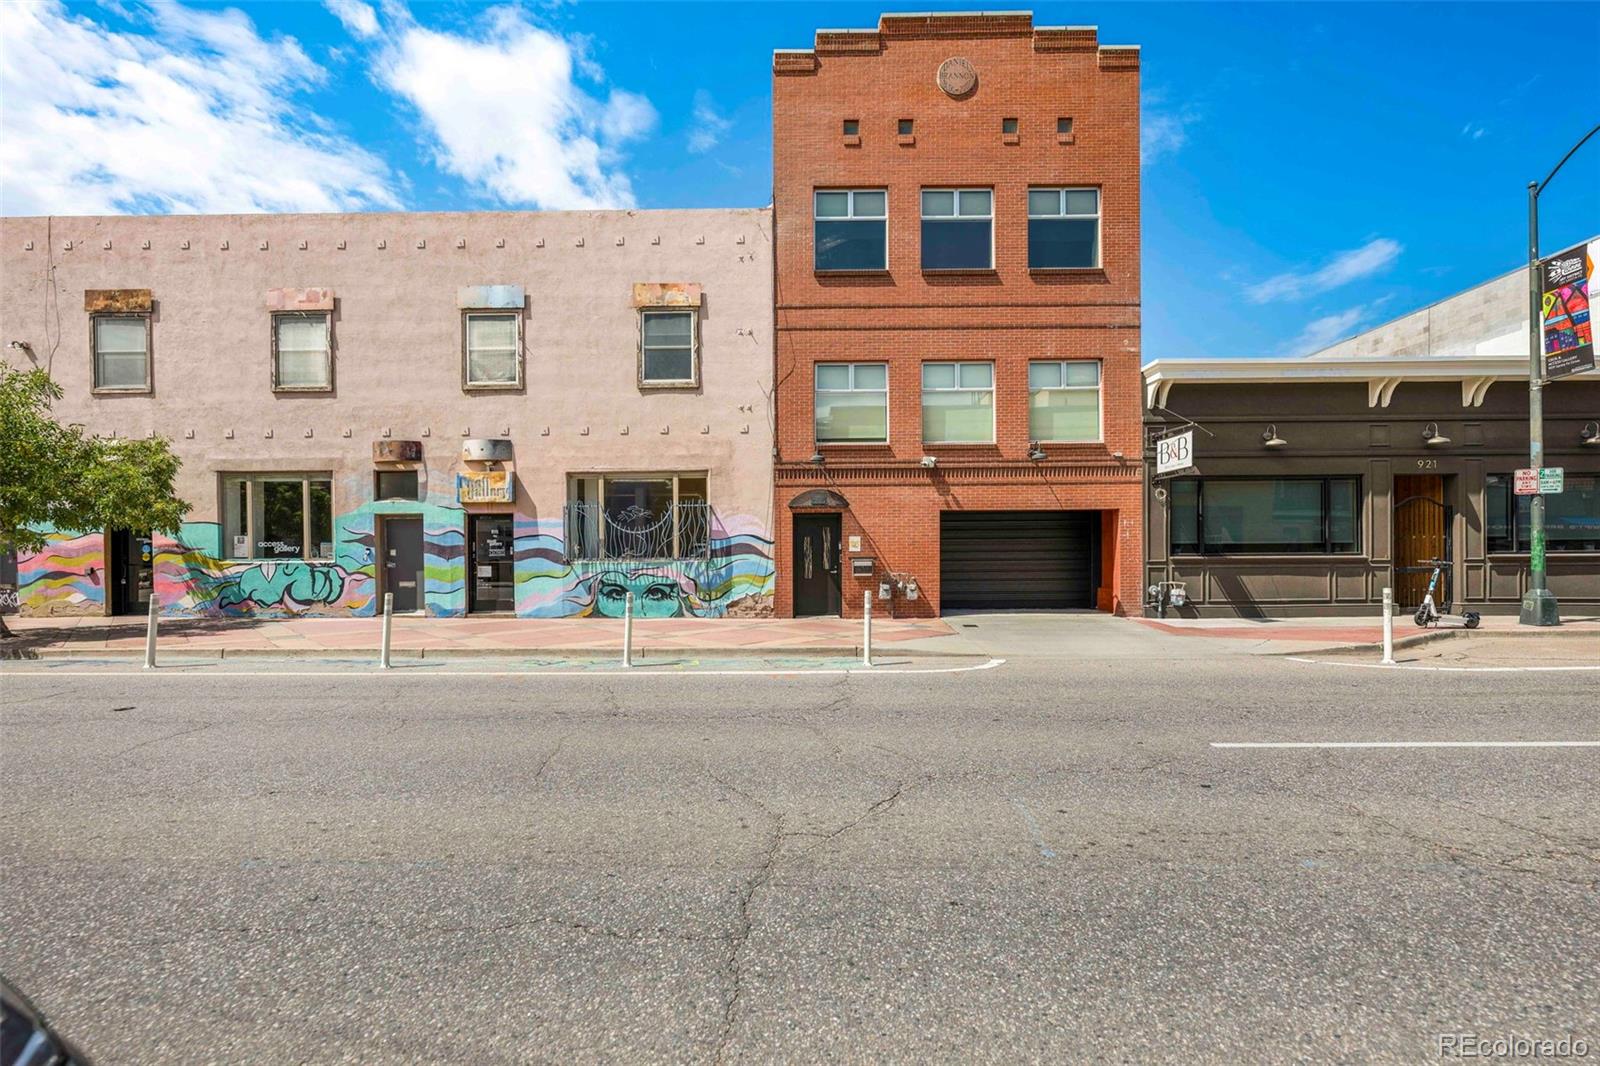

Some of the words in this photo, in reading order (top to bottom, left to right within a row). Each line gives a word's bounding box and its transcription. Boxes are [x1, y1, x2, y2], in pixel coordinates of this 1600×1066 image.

[1158, 436, 1189, 465] B&B
[1417, 460, 1437, 469] 921
[274, 545, 300, 554] gallery
